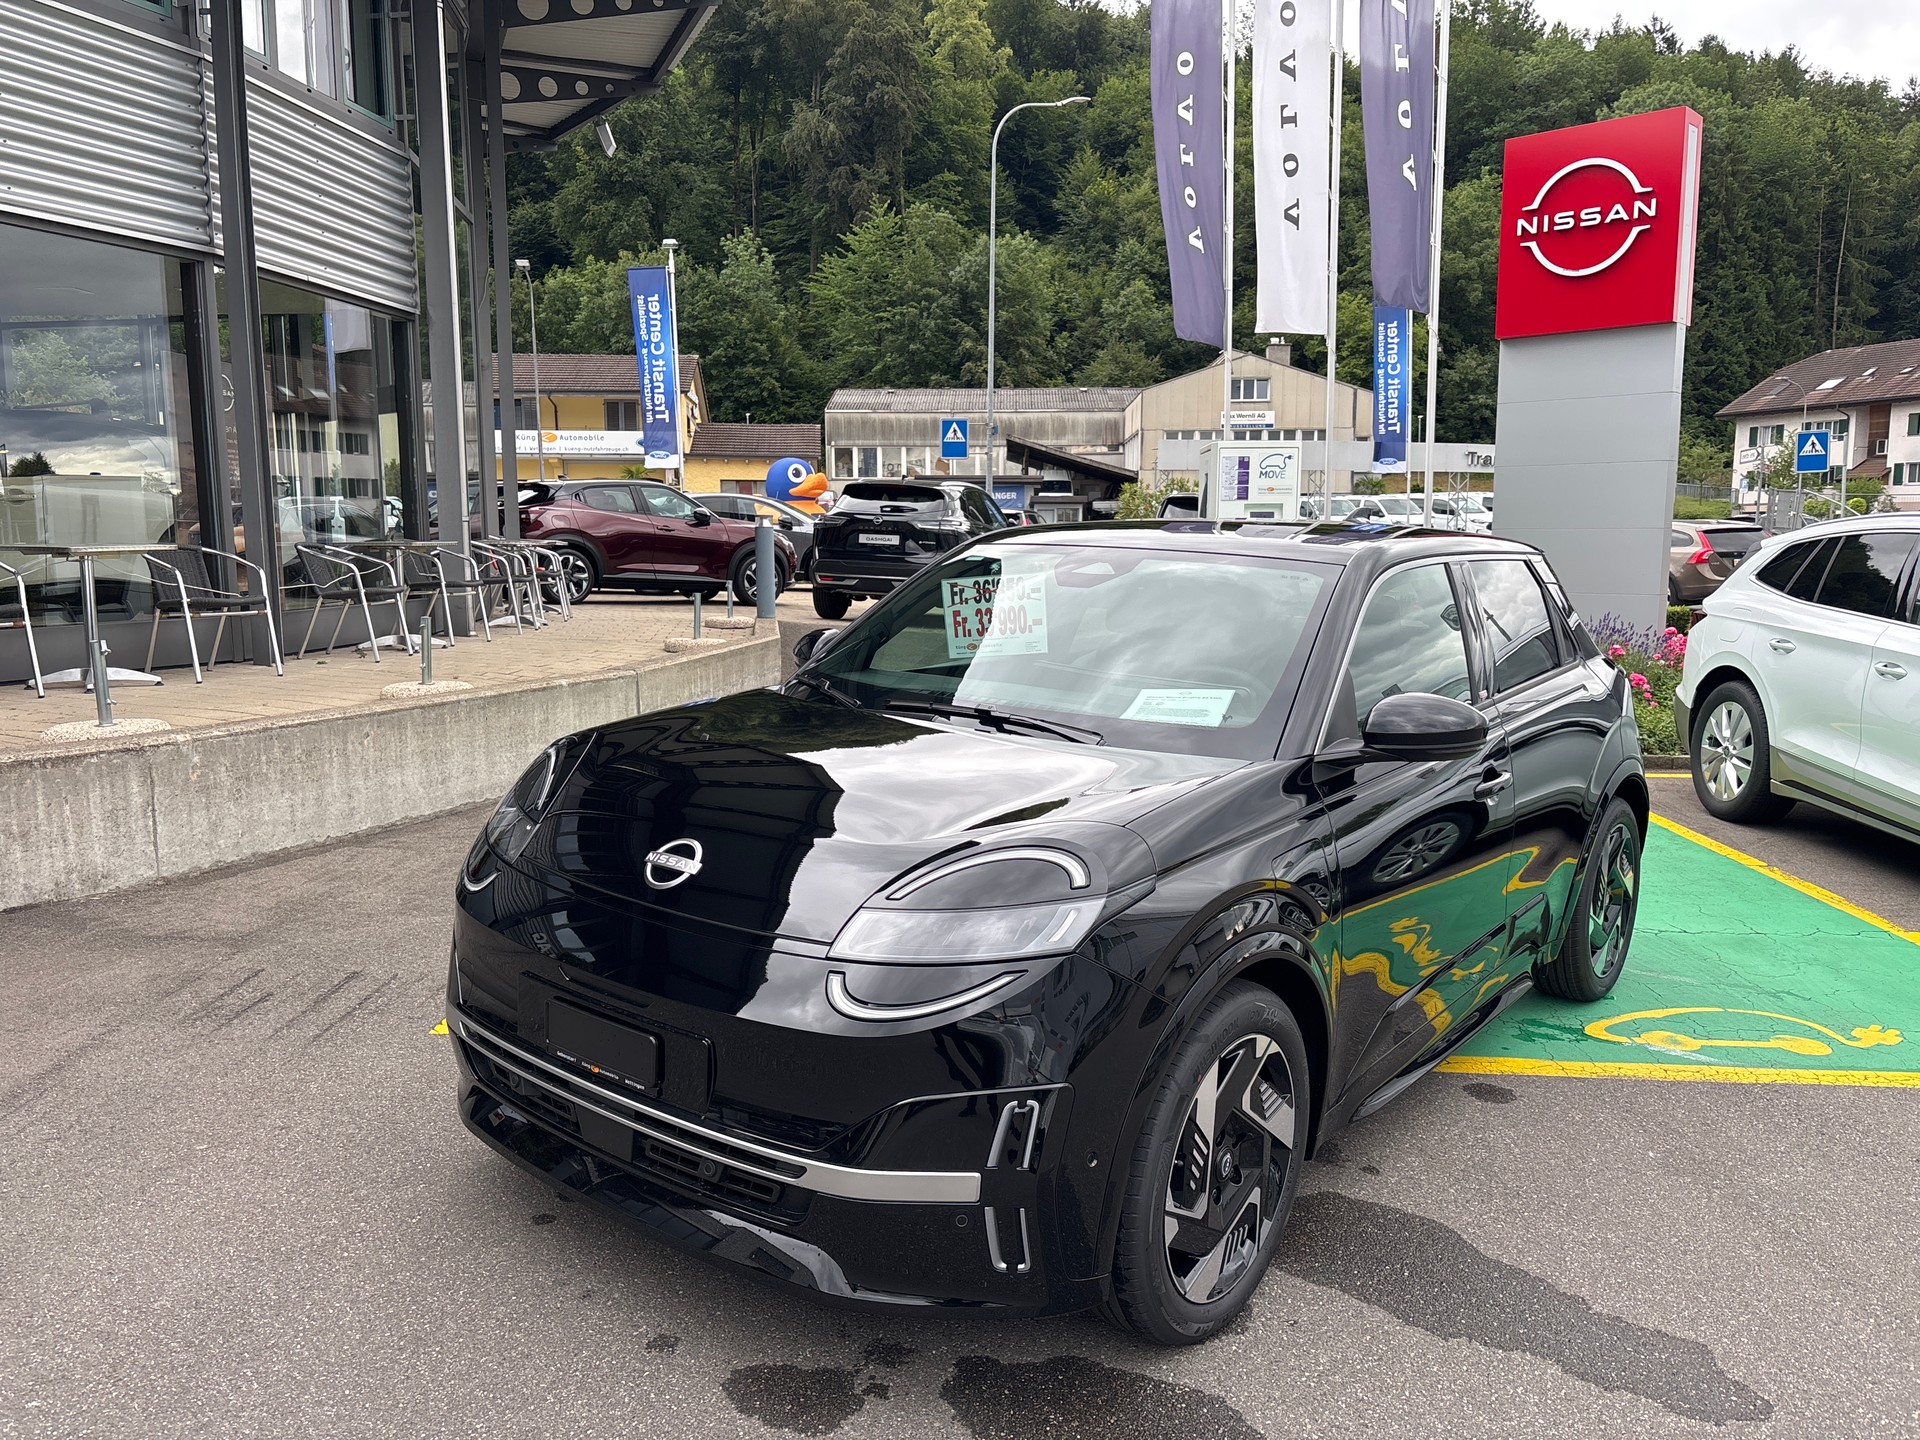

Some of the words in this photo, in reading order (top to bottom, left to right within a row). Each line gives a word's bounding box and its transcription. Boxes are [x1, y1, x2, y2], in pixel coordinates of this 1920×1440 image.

[1516, 198, 1657, 236] NISSAN
[1465, 451, 1494, 466] Tra
[1259, 470, 1286, 479] MOVE
[991, 492, 1017, 500] ANGER
[950, 582, 969, 605] Fr.
[953, 610, 972, 638] Fr.
[645, 852, 699, 874] NISSAN
